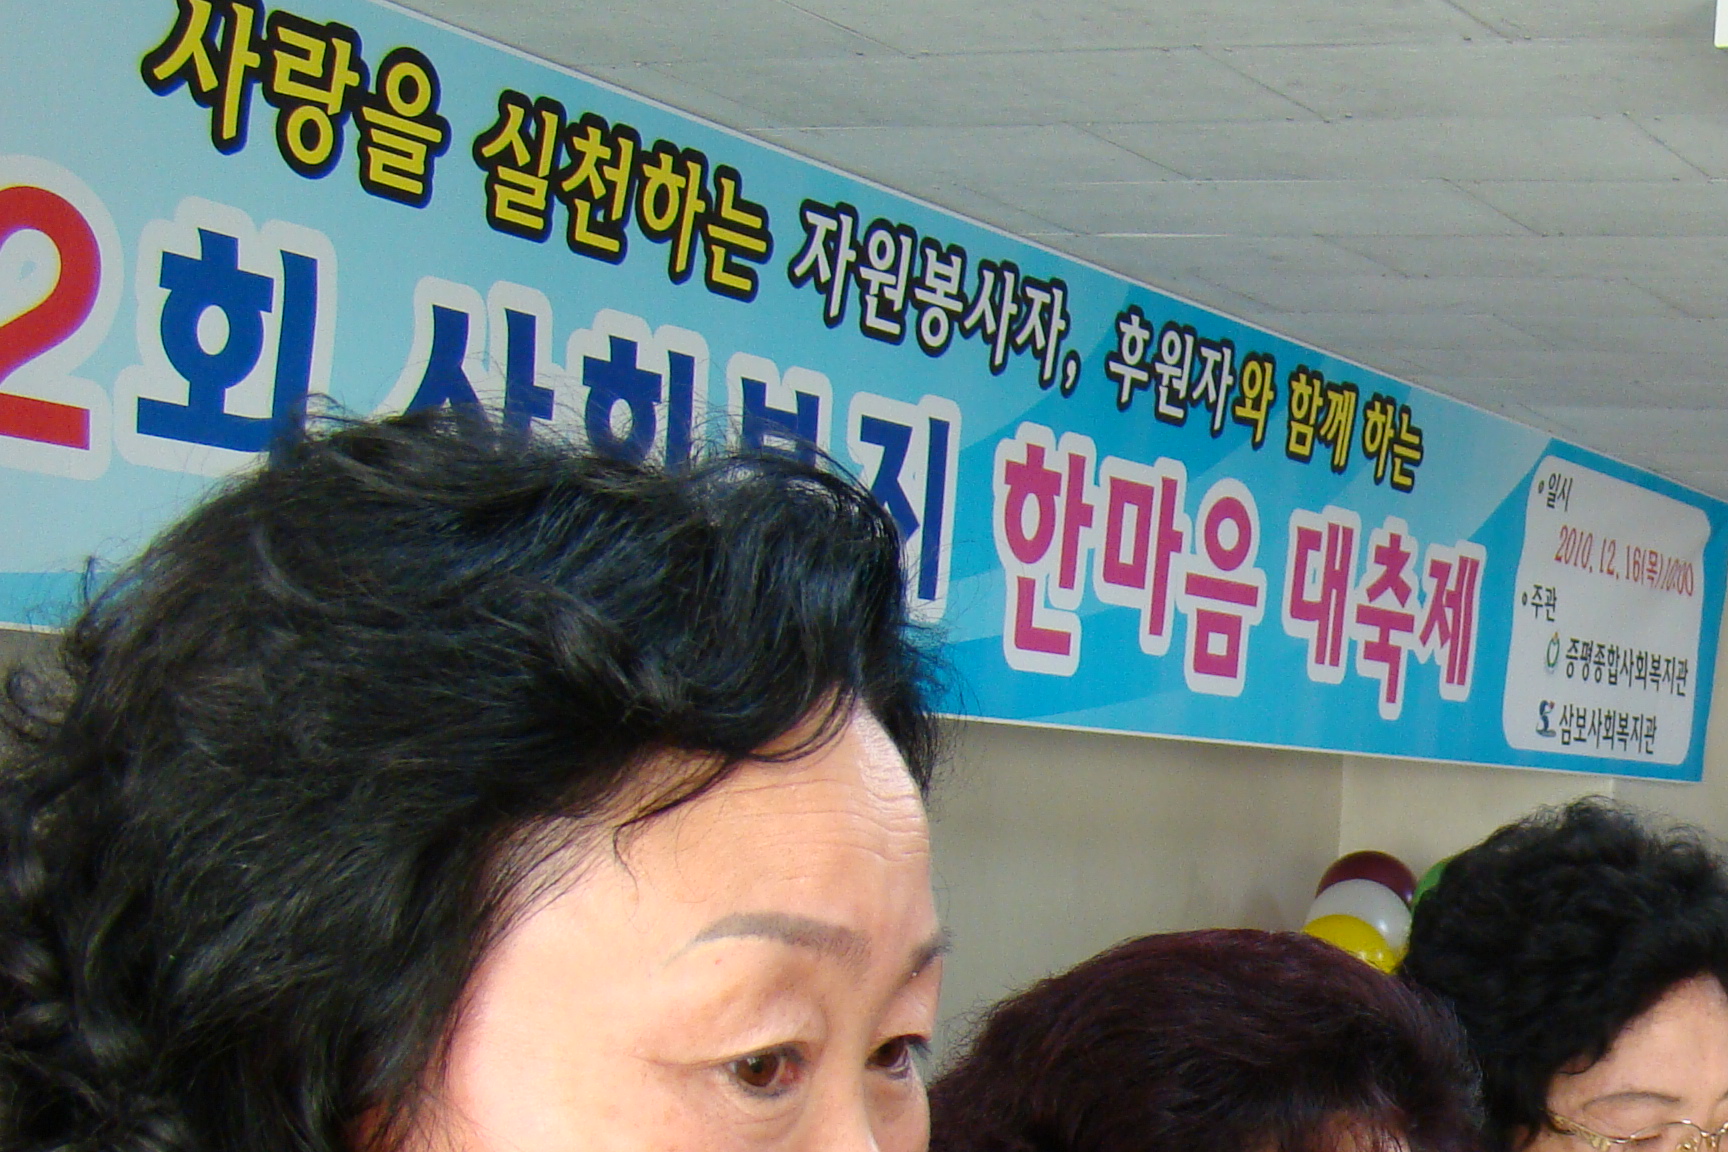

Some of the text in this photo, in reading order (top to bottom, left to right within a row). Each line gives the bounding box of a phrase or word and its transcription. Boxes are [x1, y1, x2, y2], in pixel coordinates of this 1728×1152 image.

[147, 0, 1423, 488] 사랑을 실천하는 자원봉사자, 후원자와 함께 하는
[1546, 472, 1573, 512] 일시
[1003, 441, 1260, 679] 한마음
[1288, 521, 1480, 704] 대축제
[1530, 584, 1557, 622] 주관
[1565, 637, 1689, 697] 증평종합사회복지관
[1558, 703, 1658, 755] 삼보사회복지관
